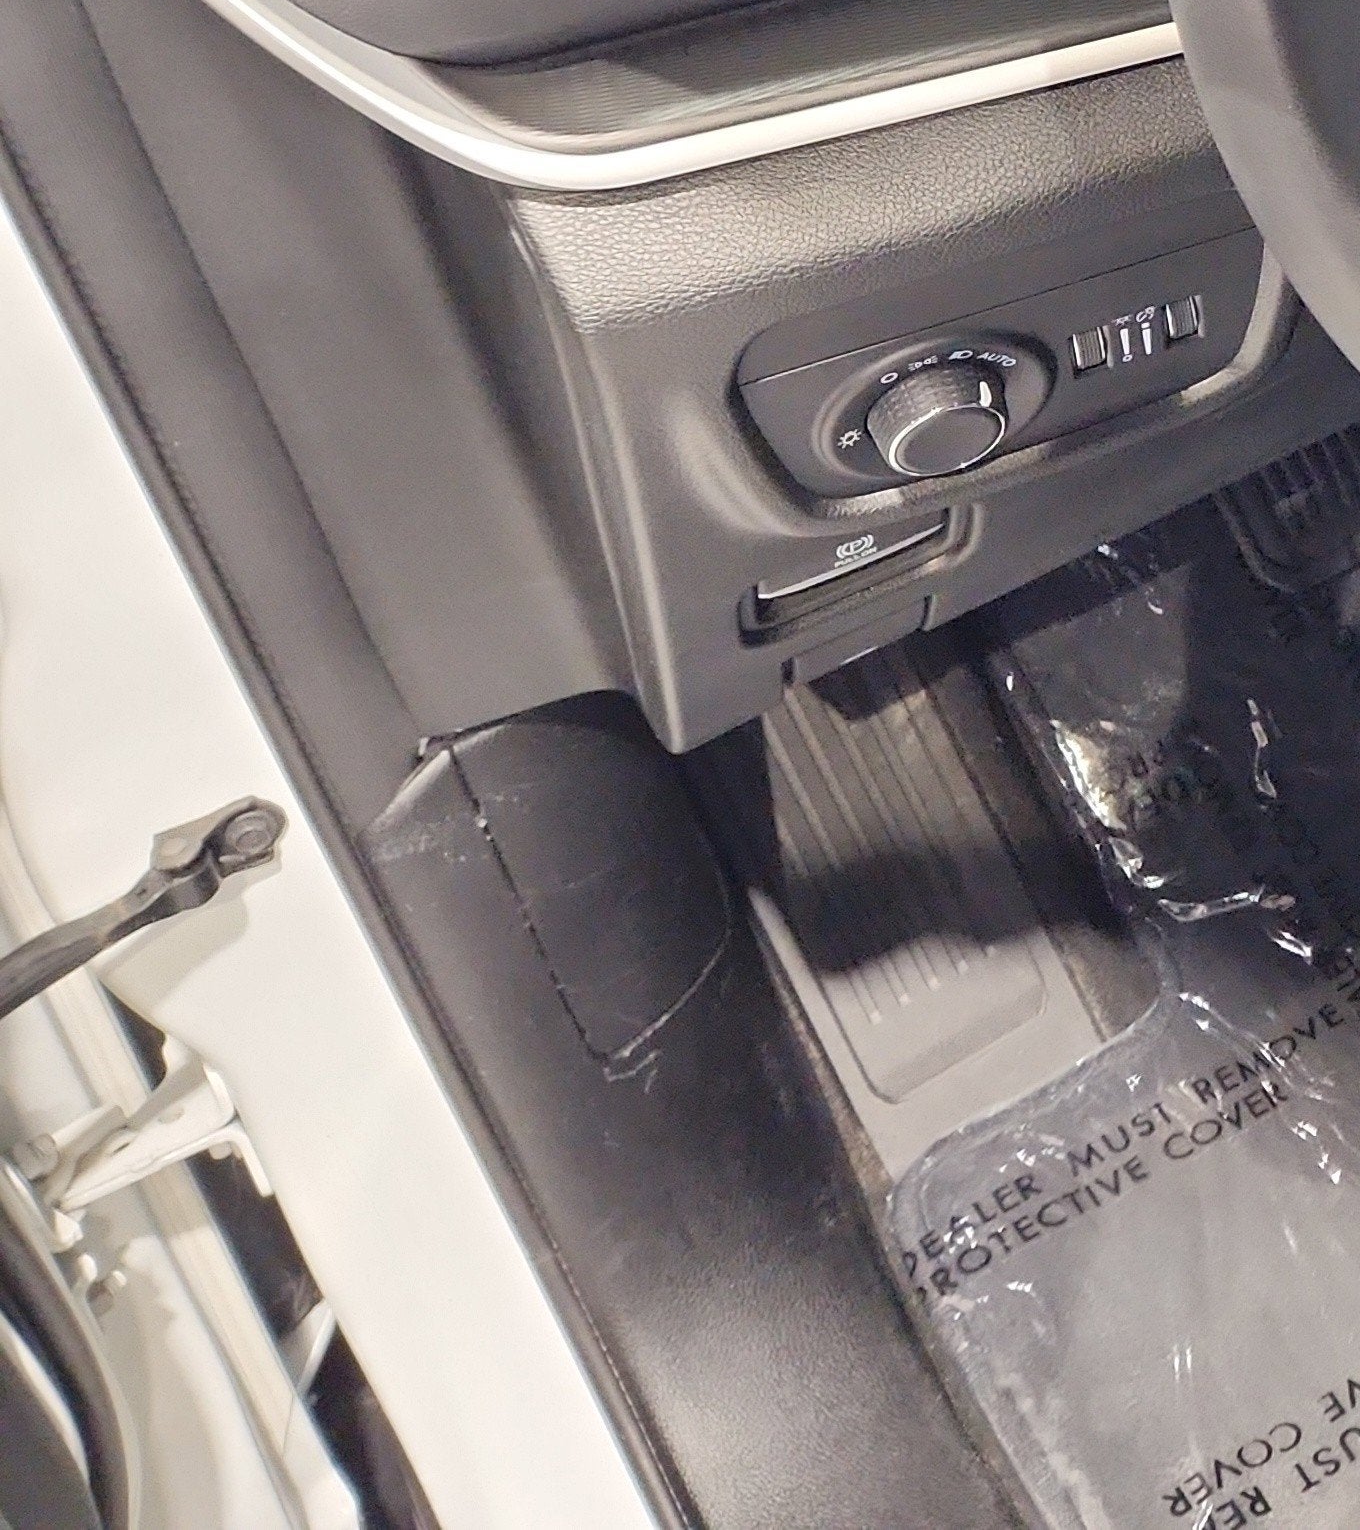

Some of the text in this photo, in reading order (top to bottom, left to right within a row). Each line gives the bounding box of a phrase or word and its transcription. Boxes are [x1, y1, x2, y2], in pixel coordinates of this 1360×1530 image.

[977, 352, 1017, 367] AUTO
[1067, 1101, 1173, 1177] MUST
[1192, 1002, 1346, 1104] REMOVE
[1161, 1081, 1289, 1161] COVER
[1161, 1420, 1304, 1519] COVER
